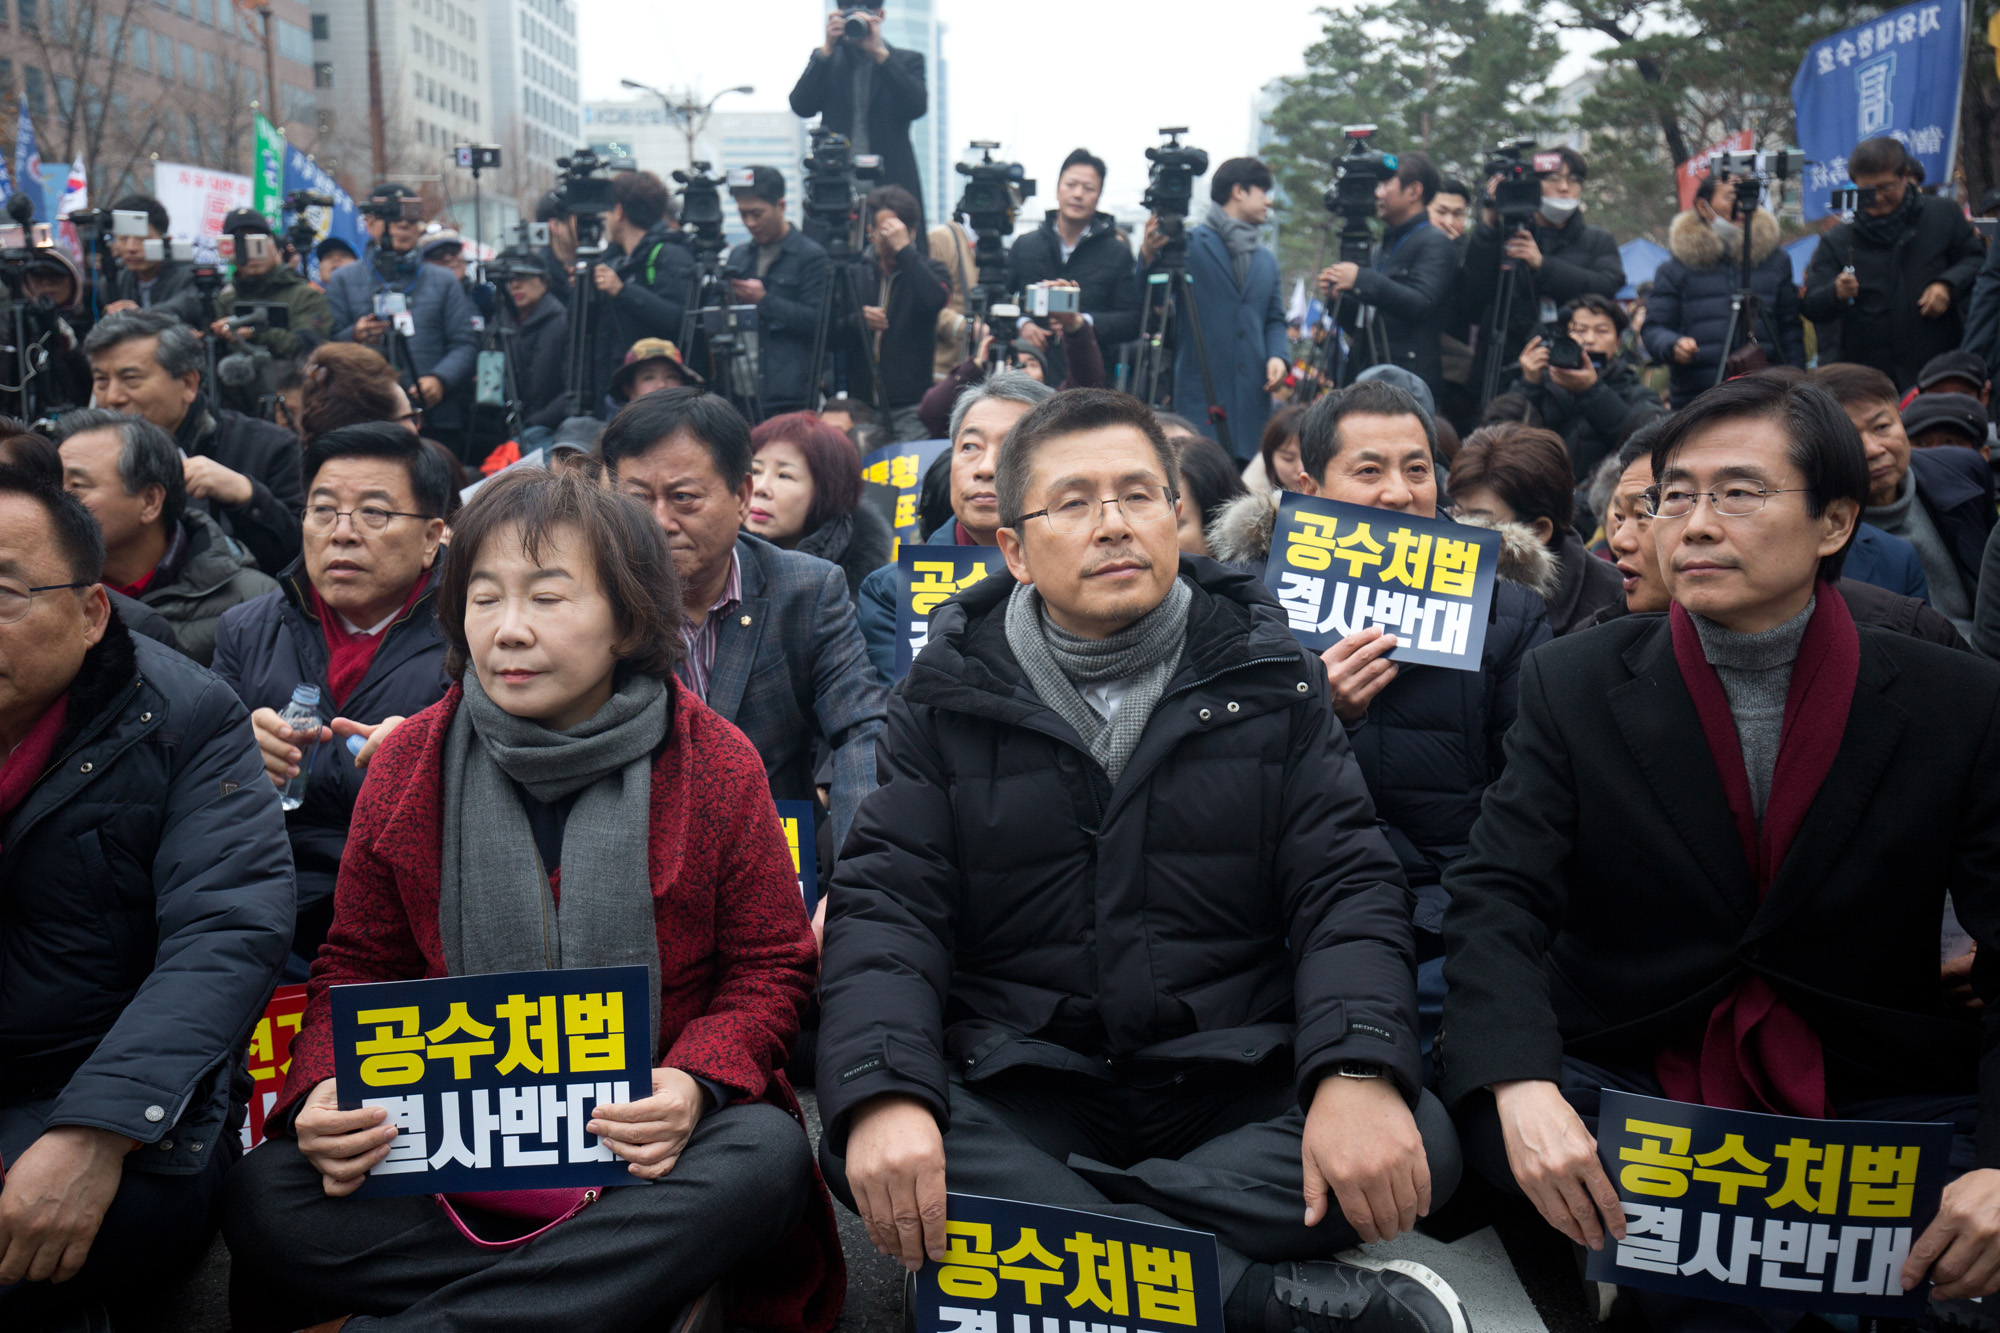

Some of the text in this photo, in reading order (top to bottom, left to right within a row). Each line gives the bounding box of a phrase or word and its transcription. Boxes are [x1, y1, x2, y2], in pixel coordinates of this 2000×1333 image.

[1286, 511, 1480, 598] 공수처법
[1277, 571, 1473, 656] 결사반대
[355, 991, 627, 1087] 공수처법
[843, 1059, 880, 1078] REDFACE
[1619, 1118, 1921, 1218] 공수처법
[935, 1220, 1198, 1327] 공수처법
[1615, 1201, 1913, 1297] 결사반대
